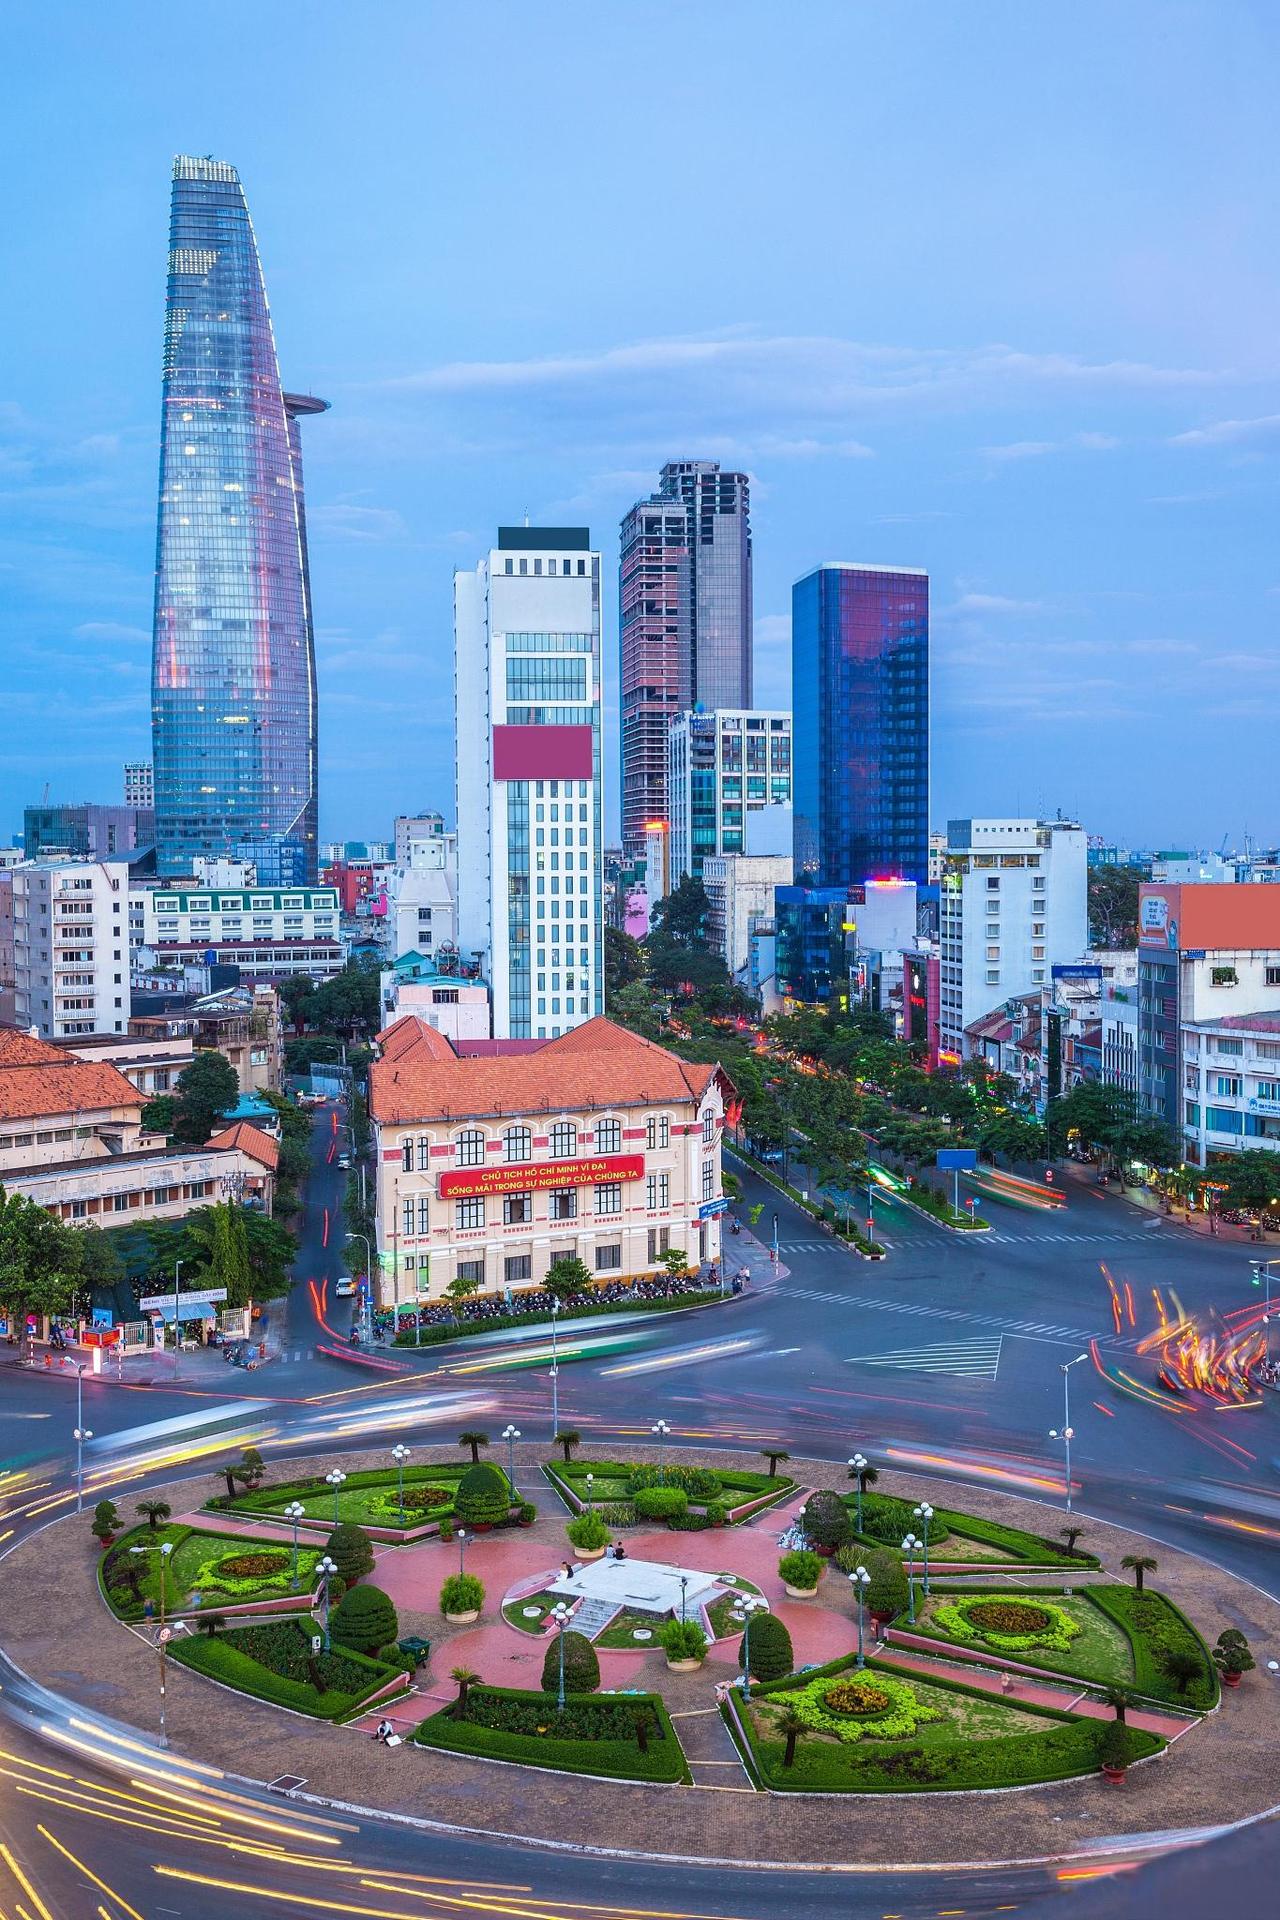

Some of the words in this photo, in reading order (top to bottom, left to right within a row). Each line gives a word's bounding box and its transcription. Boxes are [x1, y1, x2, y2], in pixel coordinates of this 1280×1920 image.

[447, 1185, 473, 1195] SỐNG
[495, 1181, 524, 1191] TRONG
[539, 1175, 572, 1186] NGHIỆP
[628, 1169, 639, 1178] TA
[504, 1170, 522, 1180] TỊCH
[540, 1165, 555, 1175] CHÍ
[557, 1165, 579, 1173] MINH
[591, 1162, 607, 1171] ĐẠI
